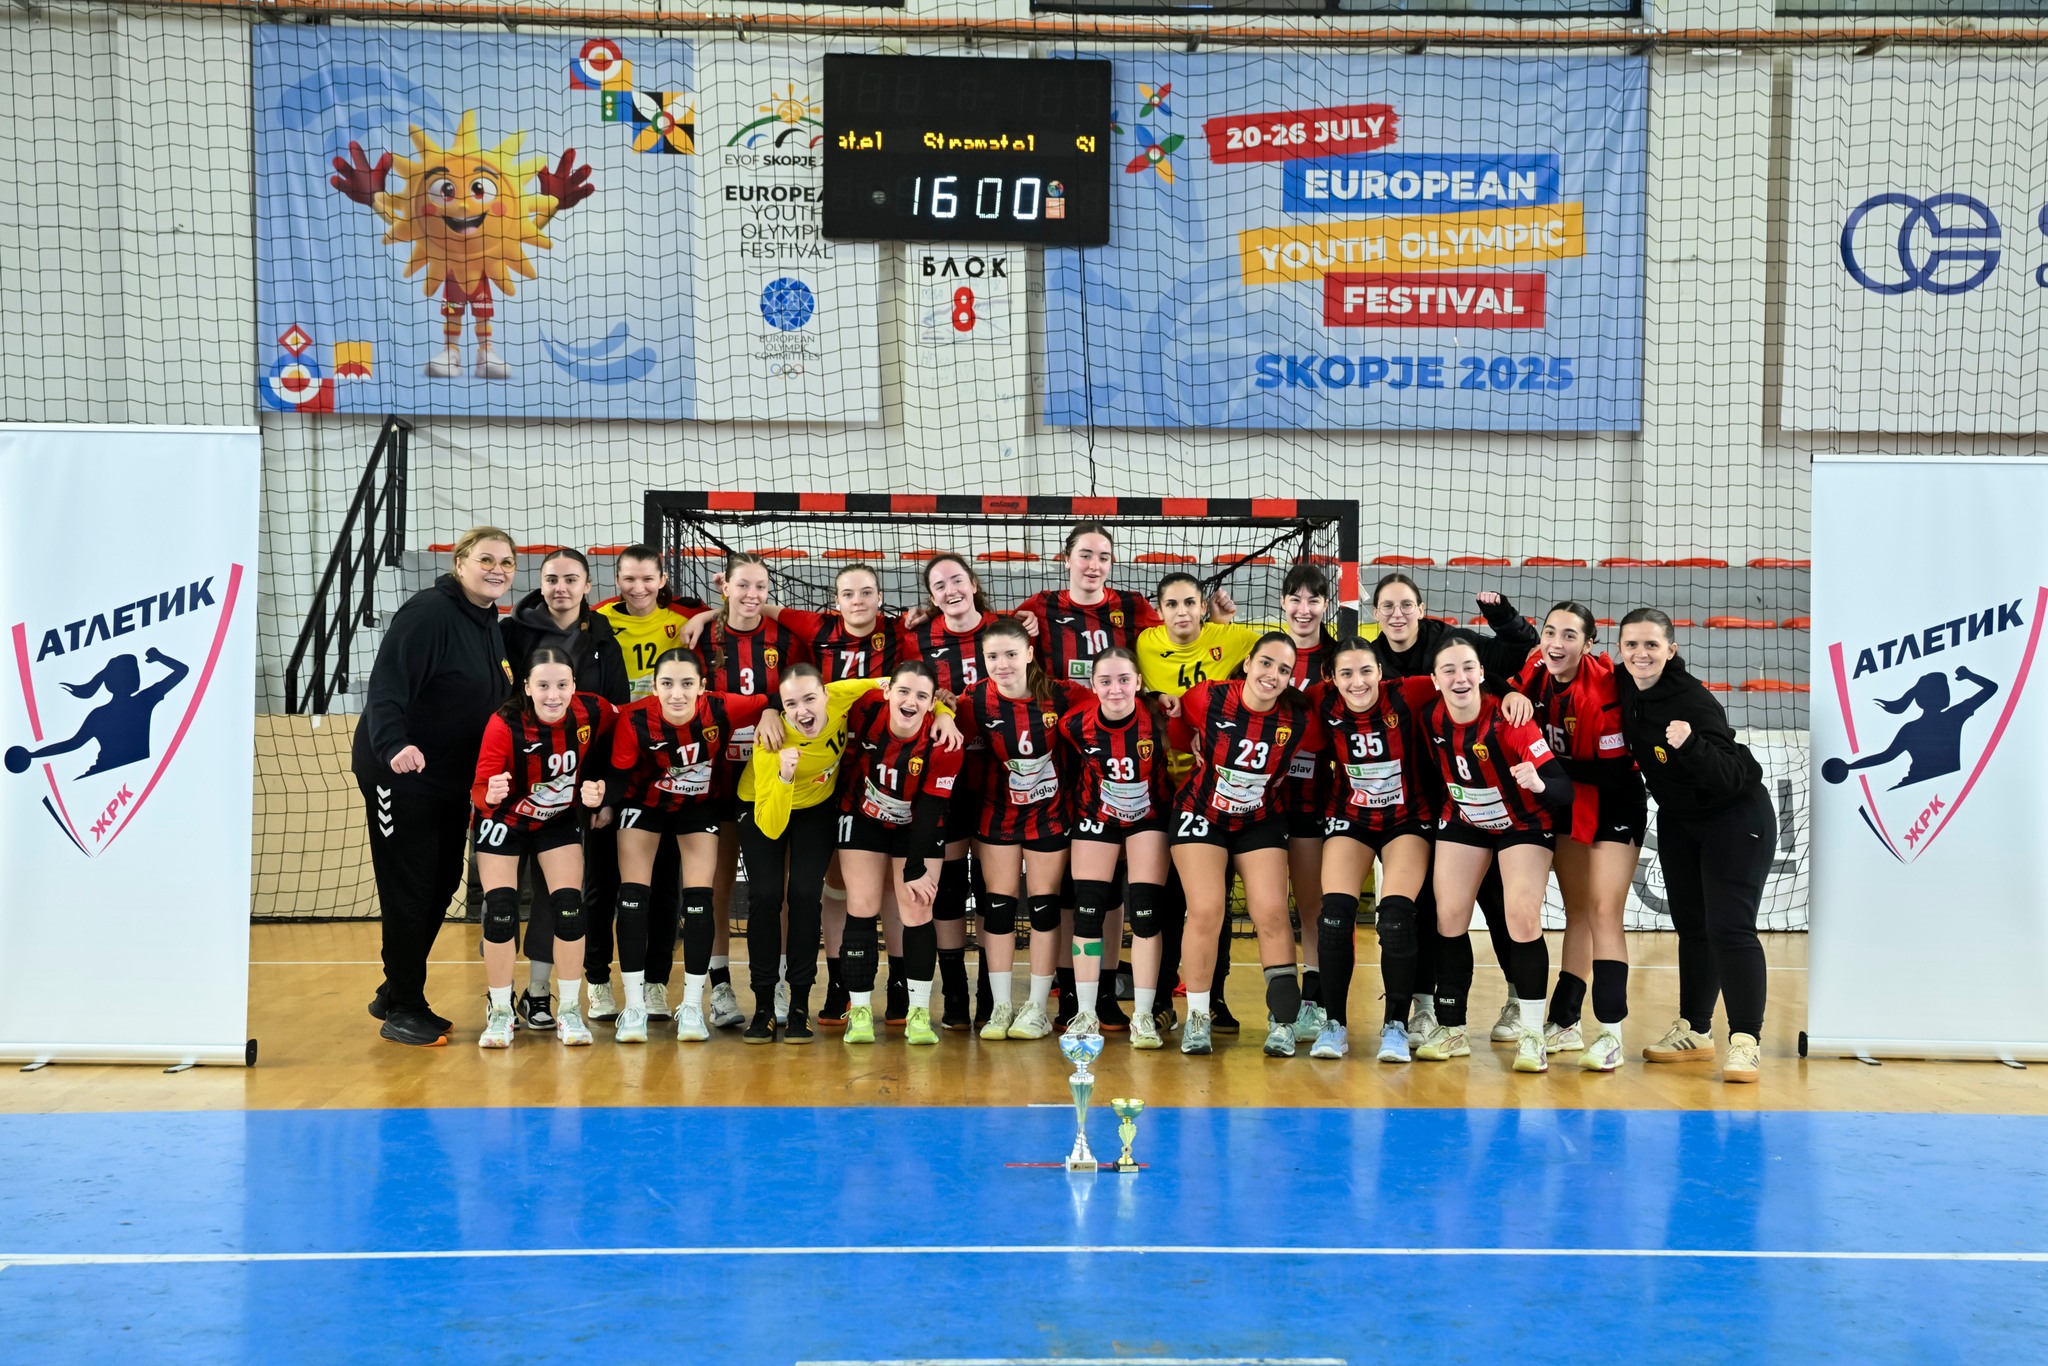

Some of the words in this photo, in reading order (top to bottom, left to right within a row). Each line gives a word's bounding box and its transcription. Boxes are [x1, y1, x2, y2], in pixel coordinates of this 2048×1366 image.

[1226, 120, 1307, 150] 20-26
[1314, 116, 1386, 144] JULY
[725, 154, 760, 165] EYOF
[763, 155, 817, 167] SKOPJE
[1304, 169, 1537, 200] EUROPEAN
[741, 223, 820, 240] OLYMPI
[740, 241, 834, 259] FESTIVAL
[1256, 236, 1388, 271] YOUTH
[1399, 220, 1567, 258] OLYMPIC
[922, 256, 1007, 278] БЛОК
[951, 286, 976, 332] 8
[1343, 287, 1524, 315] FESTIVAL
[759, 334, 815, 344] EUROPEAN
[765, 343, 810, 352] OLYMPIC
[755, 352, 820, 361] COMMITTEES
[1254, 355, 1445, 391] SKOPJE
[1459, 356, 1574, 391] 2025
[36, 576, 215, 663] АТЛЕТИК
[1081, 629, 1109, 655] 10
[1852, 598, 2024, 680] АТЛЕТИК
[632, 642, 657, 671] 12
[840, 650, 866, 678] 71
[740, 667, 755, 695] 3
[962, 657, 978, 685] 5
[1177, 661, 1207, 690] 46
[825, 728, 846, 756] 16
[1018, 730, 1034, 755] 6
[1350, 731, 1383, 758] 35
[1545, 723, 1566, 753] 15
[547, 750, 577, 777] 90
[676, 742, 700, 766] 17
[1233, 739, 1269, 770] 23
[1456, 755, 1472, 780] 8
[876, 763, 899, 791] 11
[1106, 757, 1135, 780] 33
[1290, 763, 1312, 774] glav
[674, 783, 705, 793] triglav
[1029, 784, 1057, 800] triglav
[1369, 793, 1401, 806] triglav
[89, 782, 135, 843] ЖРК
[619, 808, 642, 829] 17
[1118, 808, 1147, 820] triglav
[1177, 811, 1210, 837] 23
[1903, 793, 1946, 850] ЖРК
[476, 818, 508, 847] 90
[838, 815, 854, 843] 11
[1079, 906, 1096, 914] SELECT
